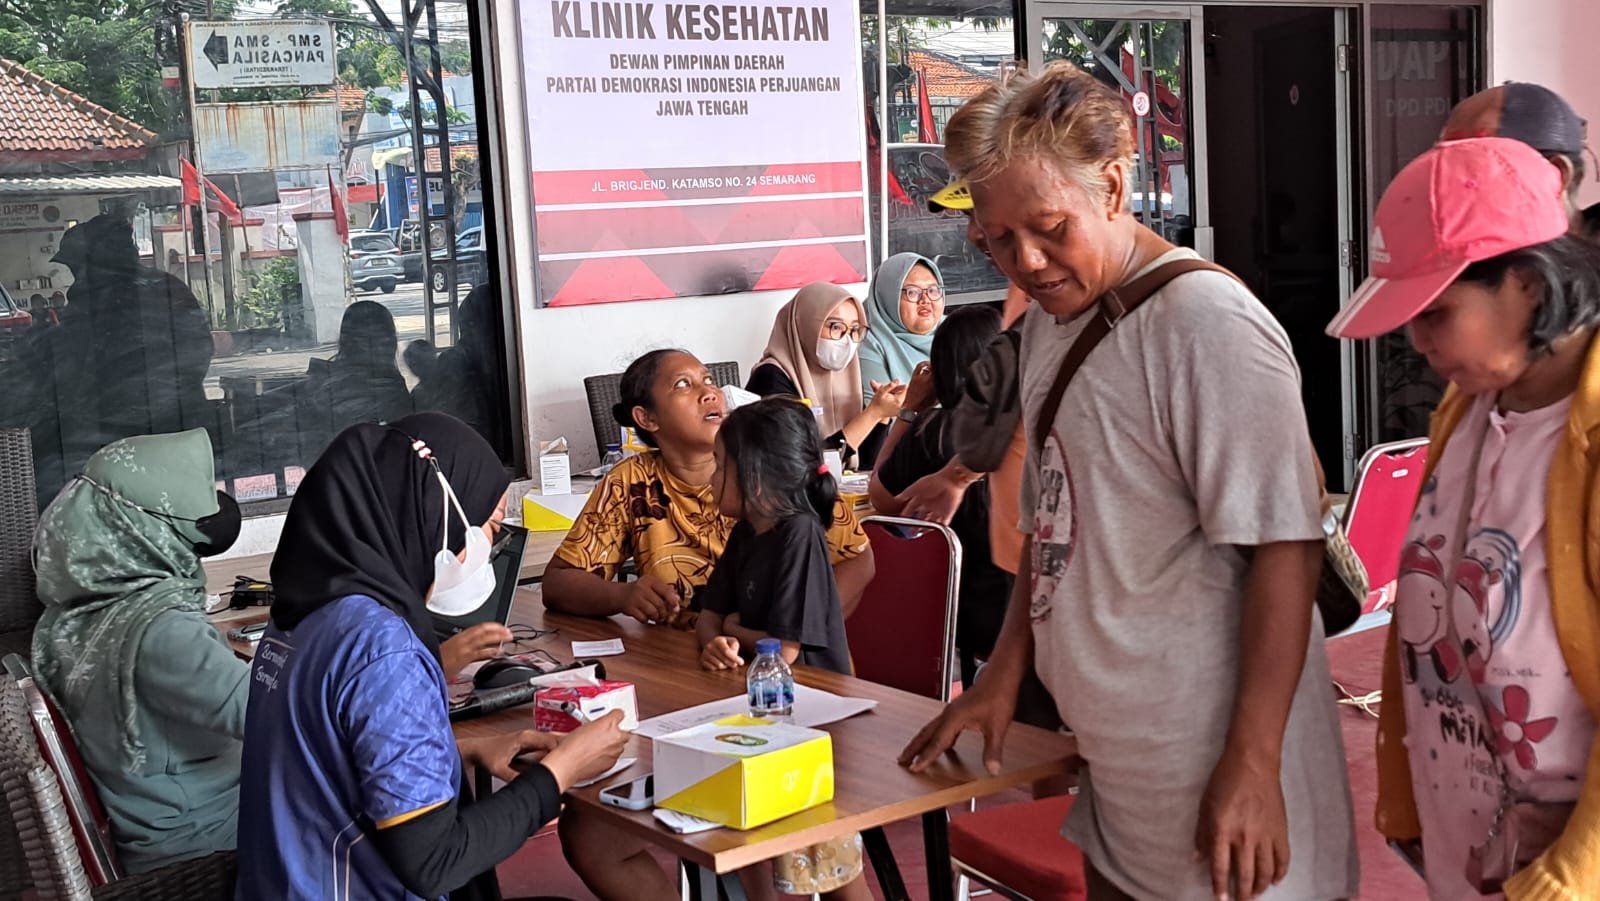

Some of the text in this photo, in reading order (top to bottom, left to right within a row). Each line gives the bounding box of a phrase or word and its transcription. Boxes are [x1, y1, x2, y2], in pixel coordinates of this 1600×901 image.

[551, 1, 829, 41] KLINIK KESEHATAN
[610, 54, 785, 70] DEWAN PIMPINAN DAERAH
[546, 77, 841, 94] PARTAI DEMOKRASI INDONESIA PERJUANGAN
[656, 100, 749, 117] JAWA TENGAH
[610, 179, 670, 192] BRIGJEND.
[671, 176, 723, 190] KATAMSO
[725, 176, 744, 188] NO.
[745, 175, 757, 187] 24
[759, 174, 816, 187] SEMARANG
